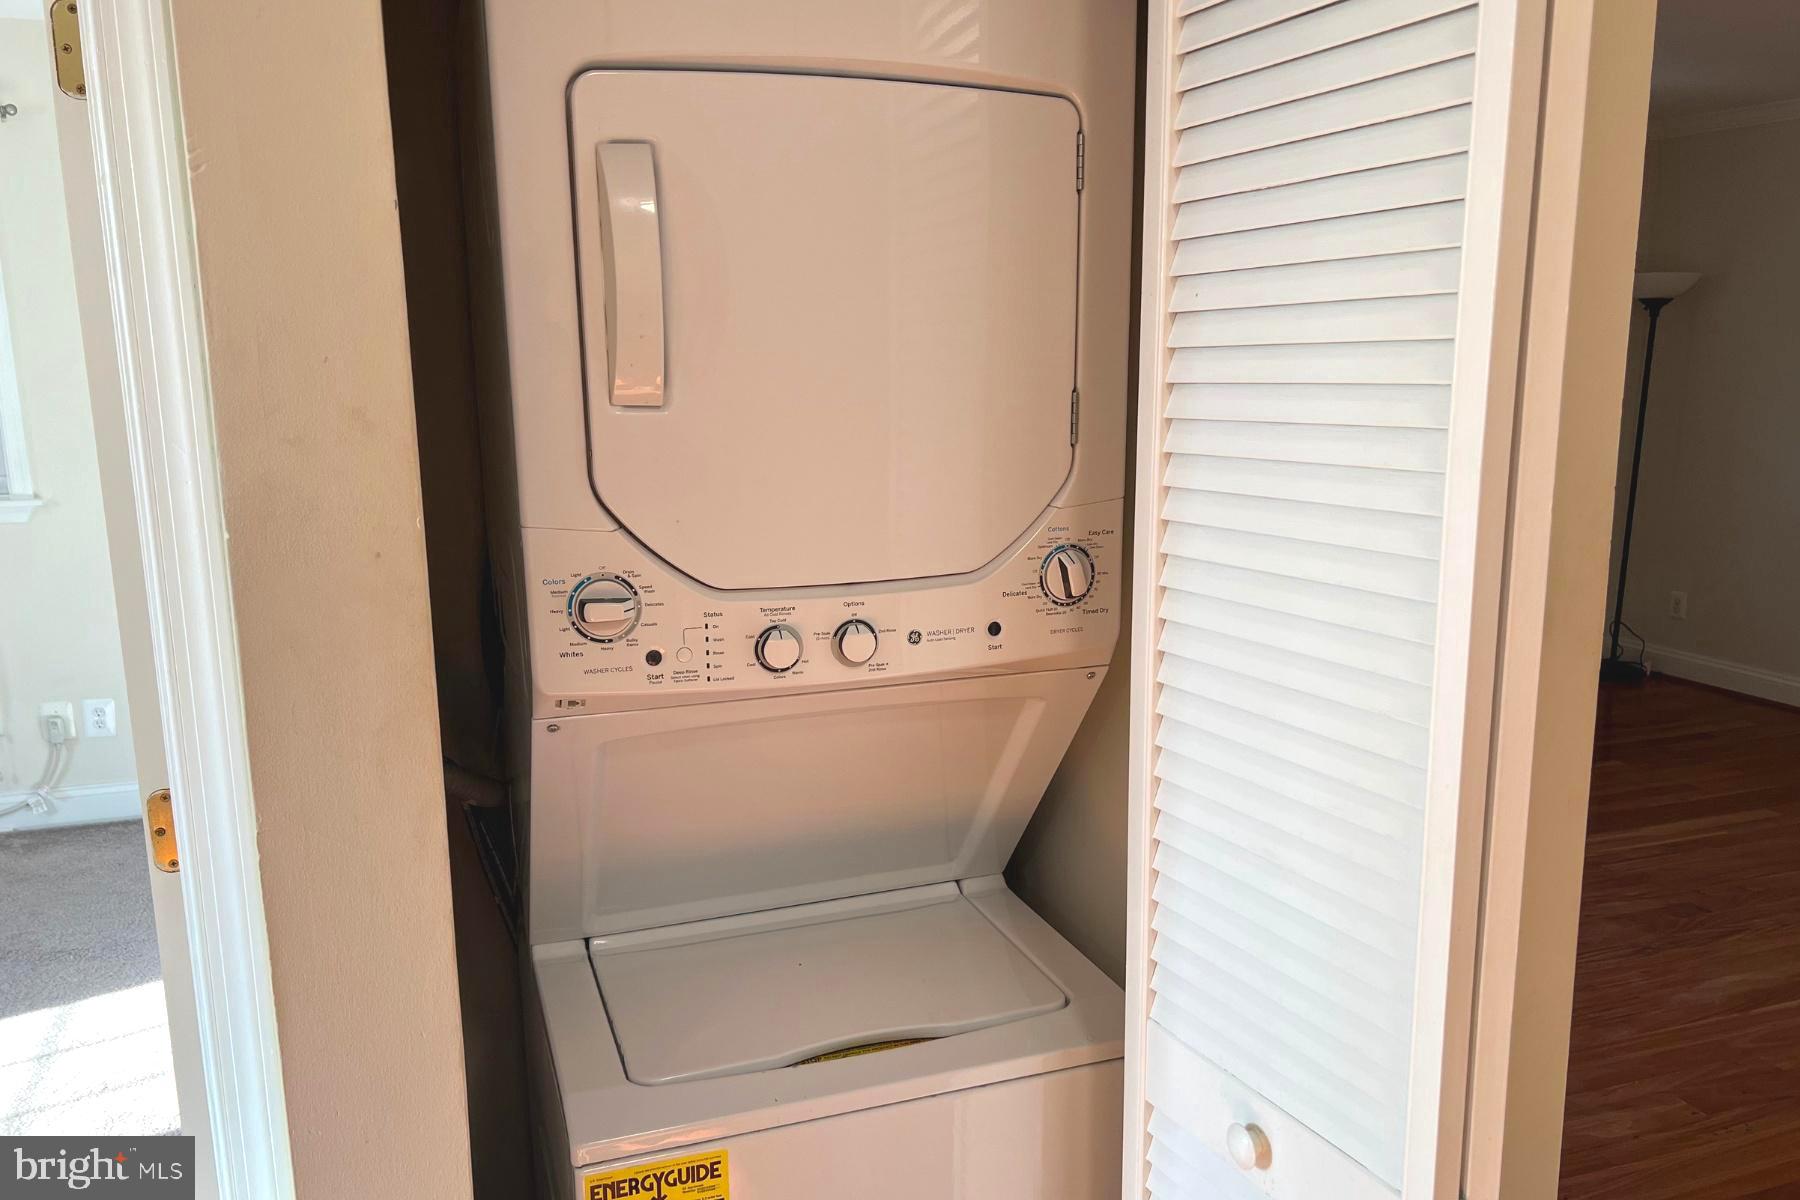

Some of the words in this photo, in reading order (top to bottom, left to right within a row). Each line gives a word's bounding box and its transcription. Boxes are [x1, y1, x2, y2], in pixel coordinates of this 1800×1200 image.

[926, 629, 952, 637] WASHER
[955, 626, 975, 635] DRYER
[583, 667, 609, 675] WASHER
[610, 665, 633, 673] CYCLES
[590, 1160, 722, 1200] ENERGYGUIDE
